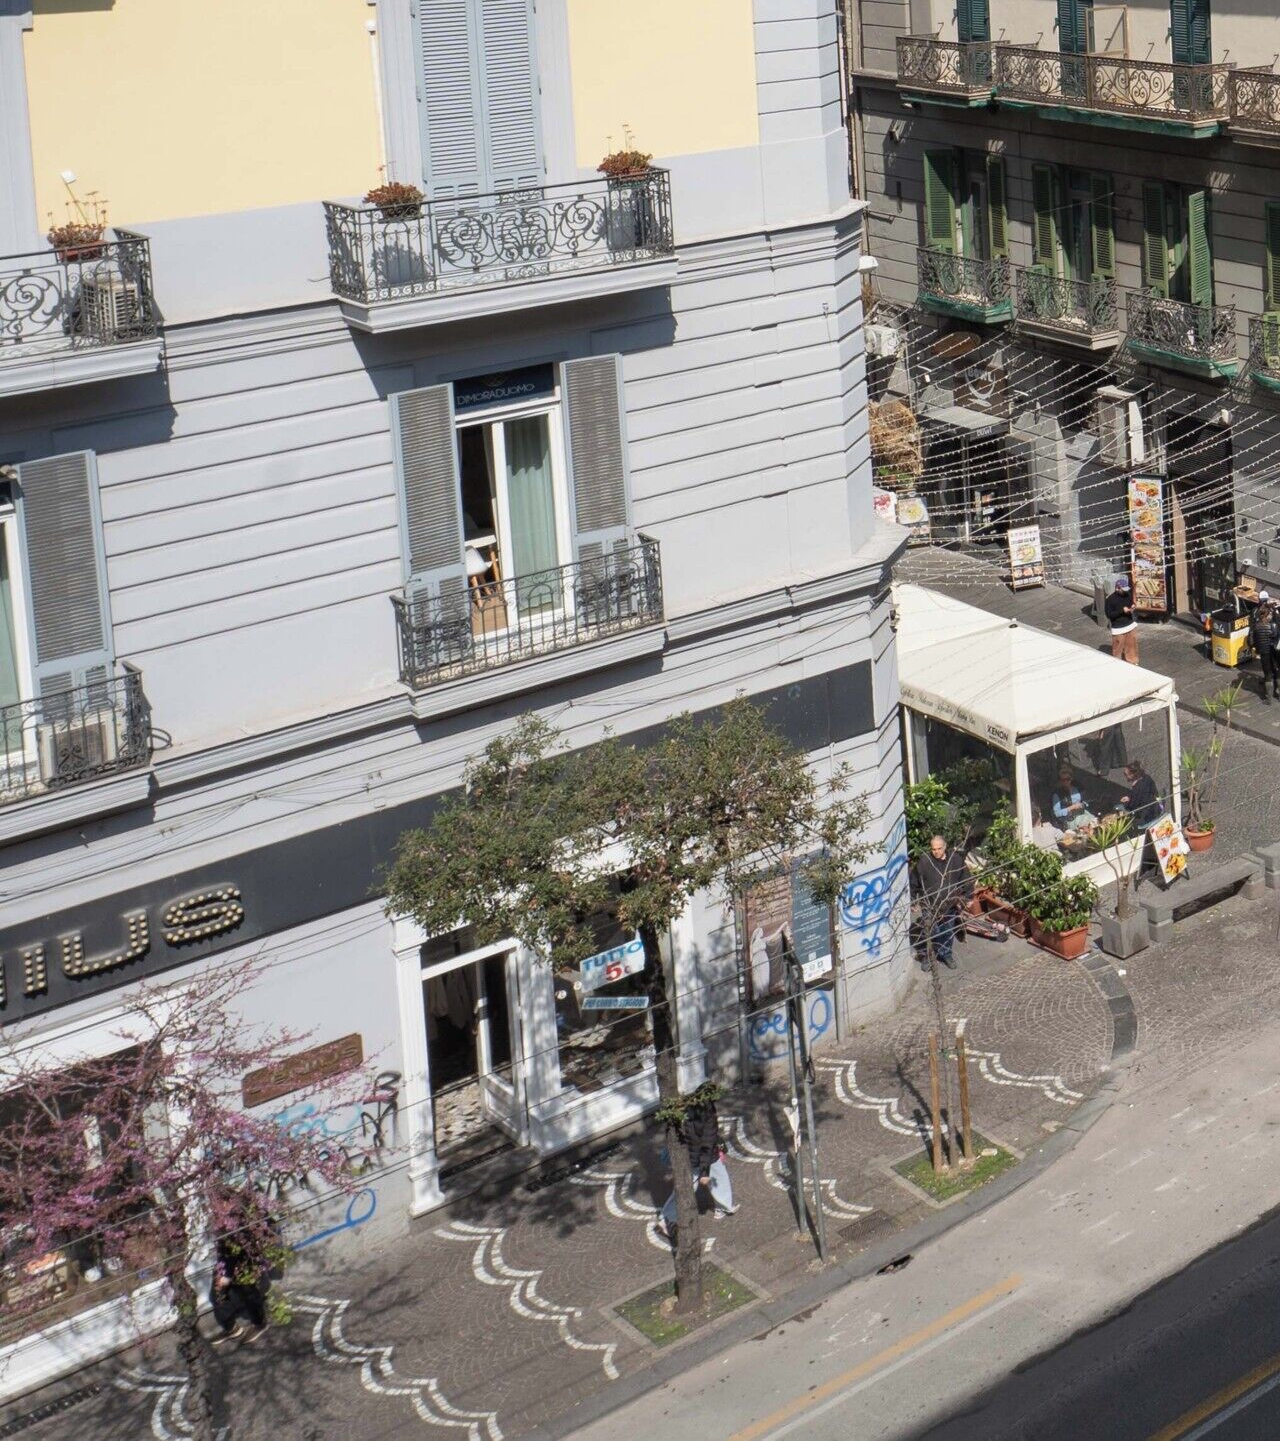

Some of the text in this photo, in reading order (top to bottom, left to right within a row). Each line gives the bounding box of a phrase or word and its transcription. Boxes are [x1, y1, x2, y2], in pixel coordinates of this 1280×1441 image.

[0, 882, 244, 1008] IUS
[582, 941, 644, 972] TUTTO
[605, 961, 622, 981] 5
